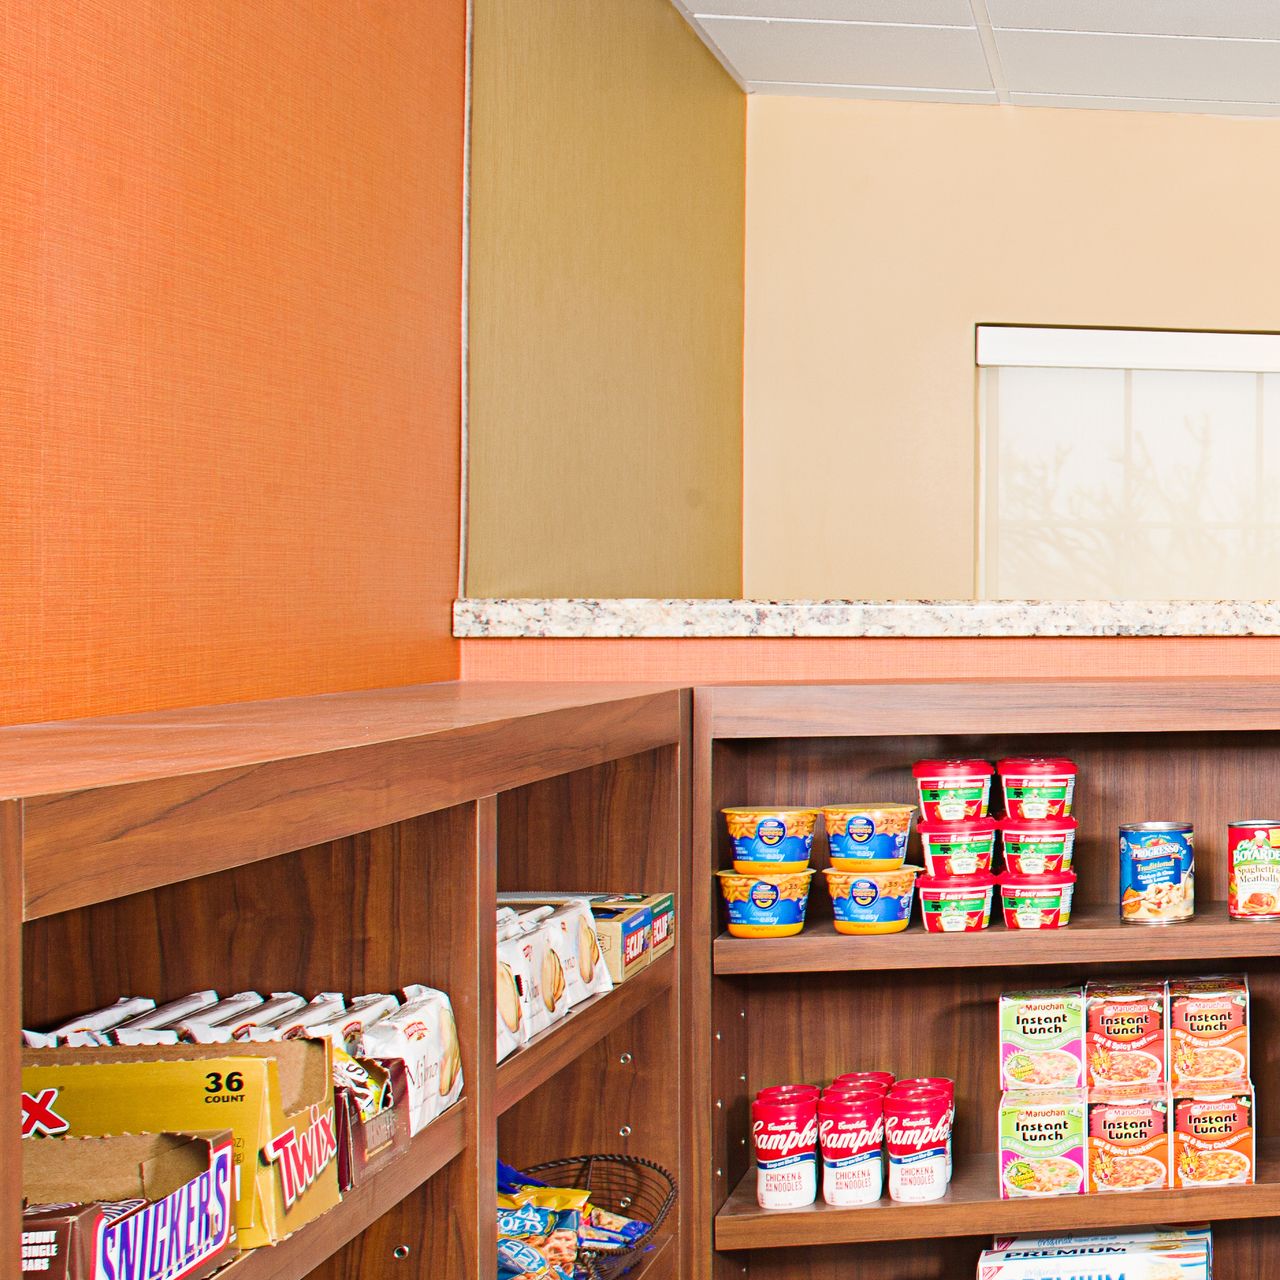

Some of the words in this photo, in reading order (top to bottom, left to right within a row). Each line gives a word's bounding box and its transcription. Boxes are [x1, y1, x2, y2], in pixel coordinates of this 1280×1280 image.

[1133, 844, 1180, 858] PROGRESSO
[1136, 859, 1175, 872] Traditional
[1237, 865, 1274, 876] Spaghetti
[1238, 874, 1280, 883] Meatballs
[1025, 1003, 1065, 1011] Maruchan
[1016, 1014, 1068, 1025] Instant
[1100, 1015, 1150, 1025] Instant
[1184, 1012, 1233, 1022] Instant
[1022, 1024, 1063, 1035] Lunch
[1106, 1025, 1144, 1035] Lunch
[1190, 1022, 1228, 1032] Lunch
[204, 1071, 244, 1093] 36
[204, 1094, 246, 1104] COUNT
[1025, 1109, 1066, 1118] Maruchan
[1187, 1113, 1238, 1125] Instant
[1015, 1120, 1068, 1132] Instant
[1102, 1119, 1153, 1130] Instant
[1194, 1123, 1233, 1134] Lunch
[1022, 1131, 1063, 1142] Lunch
[1108, 1129, 1148, 1140] Lunch
[765, 1172, 796, 1182] CHICKEN
[835, 1171, 866, 1181] CHICKEN
[901, 1167, 929, 1177] CHICKEN
[773, 1181, 803, 1192] NOODLES
[844, 1180, 872, 1190] NOODLES
[908, 1176, 935, 1186] NOODLES
[21, 1244, 59, 1258] SINGLE
[1004, 1247, 1127, 1259] PREMIUM
